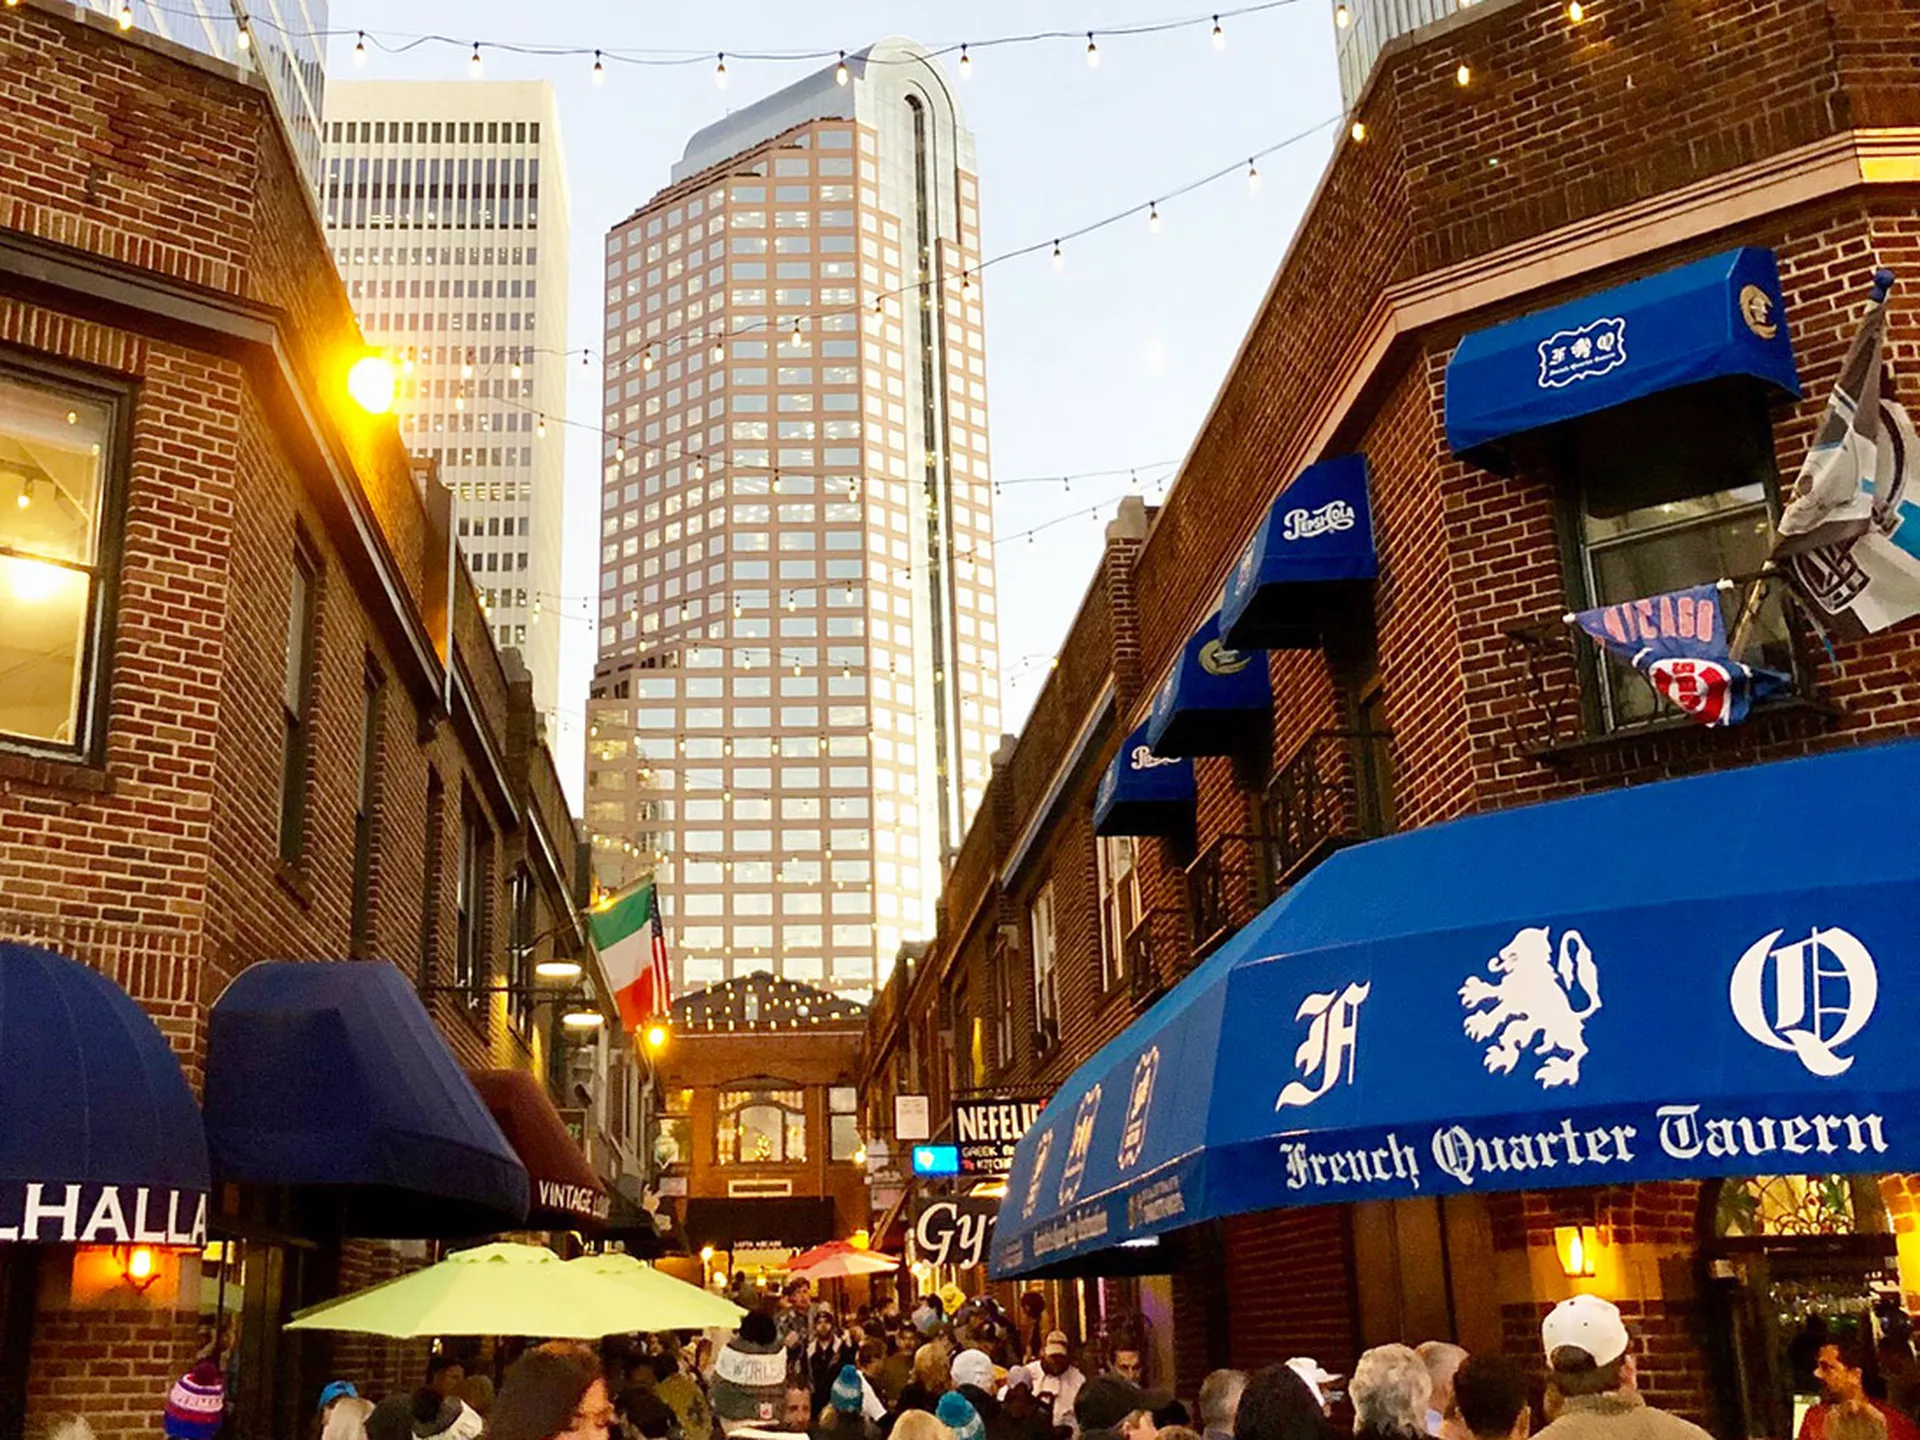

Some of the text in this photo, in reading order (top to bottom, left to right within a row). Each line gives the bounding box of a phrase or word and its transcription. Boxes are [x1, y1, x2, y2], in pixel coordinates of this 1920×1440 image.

[1729, 925, 1879, 1078] Q
[1279, 1102, 1889, 1191] French Quarter Tavern
[538, 1178, 594, 1215] VINTAGE
[916, 1201, 998, 1271] Gy
